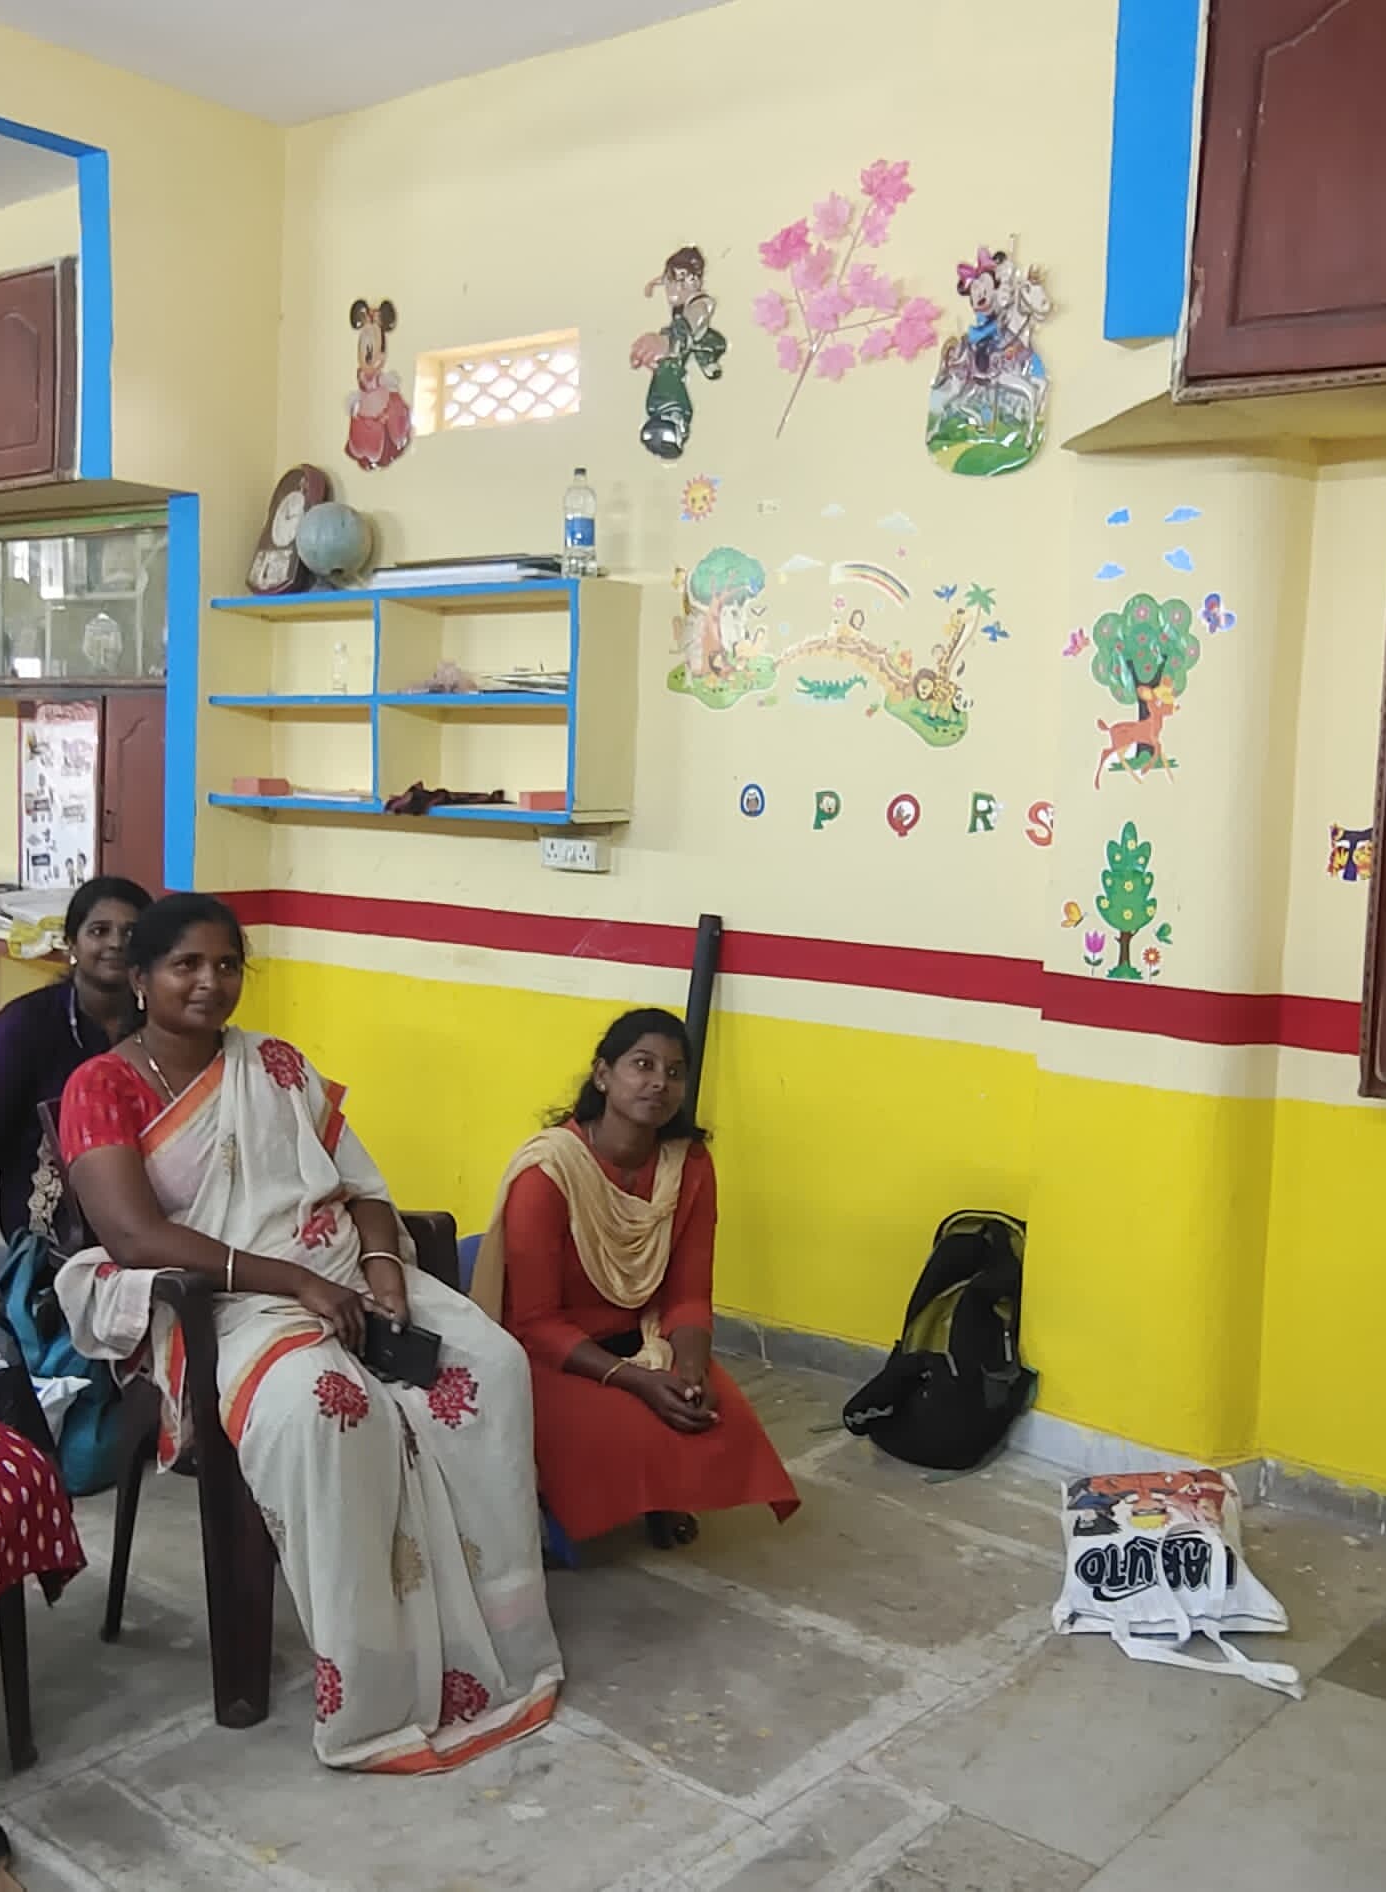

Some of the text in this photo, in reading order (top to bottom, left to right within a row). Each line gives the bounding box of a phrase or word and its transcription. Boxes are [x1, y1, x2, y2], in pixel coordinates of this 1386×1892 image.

[740, 783, 1054, 846] O P Q R S
